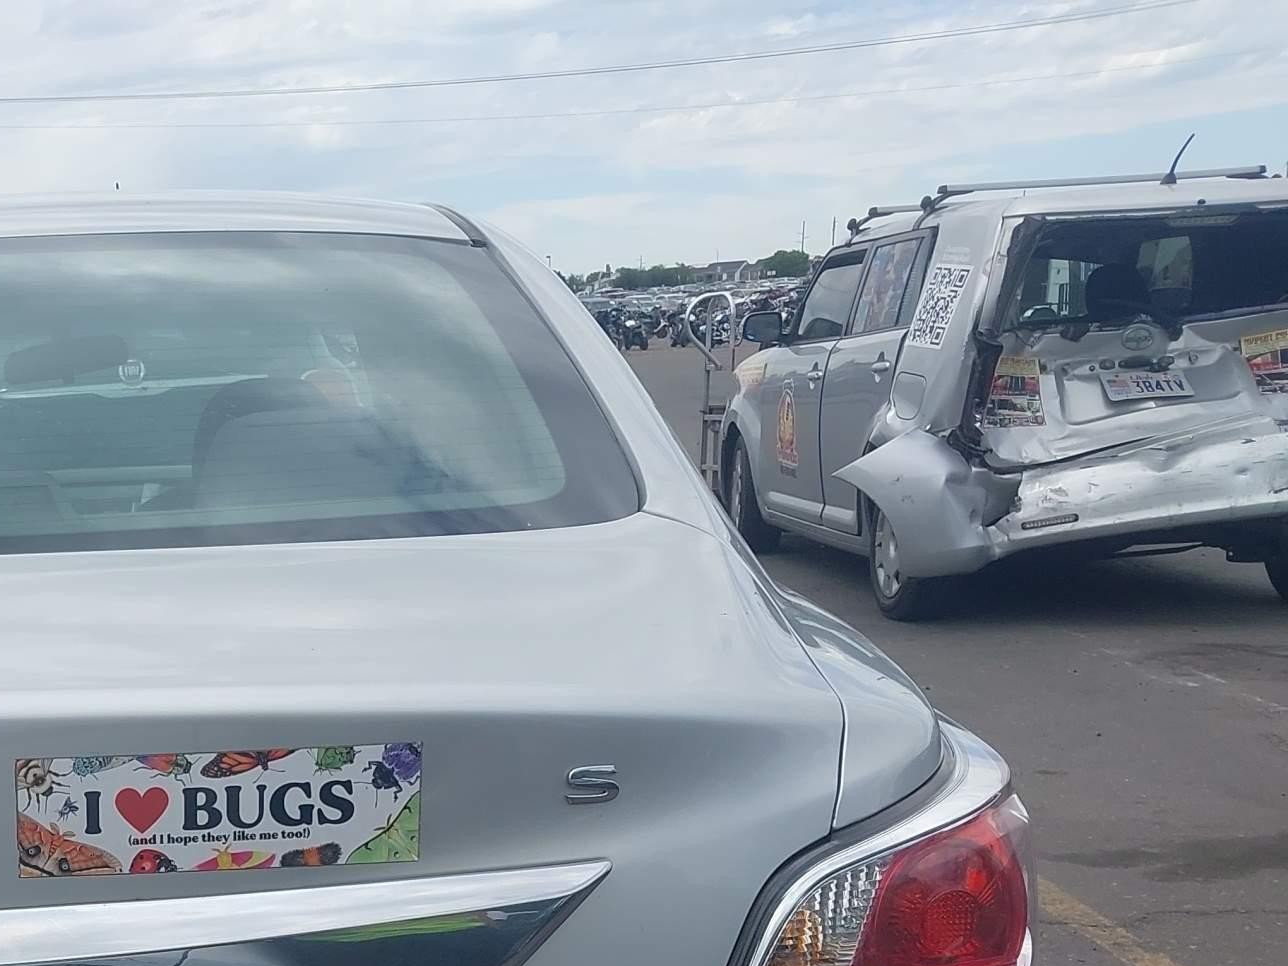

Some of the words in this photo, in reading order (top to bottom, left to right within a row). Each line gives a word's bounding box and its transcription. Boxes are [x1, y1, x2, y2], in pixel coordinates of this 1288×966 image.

[1131, 379, 1185, 394] 3B4TV
[564, 764, 620, 806] S
[84, 790, 102, 834] I
[181, 780, 355, 831] BUGS
[128, 833, 156, 846] (and
[159, 834, 165, 844] I
[166, 831, 199, 846] hope
[201, 830, 230, 845] they
[232, 829, 257, 842] like
[259, 831, 278, 840] me
[281, 827, 310, 840] too!)
